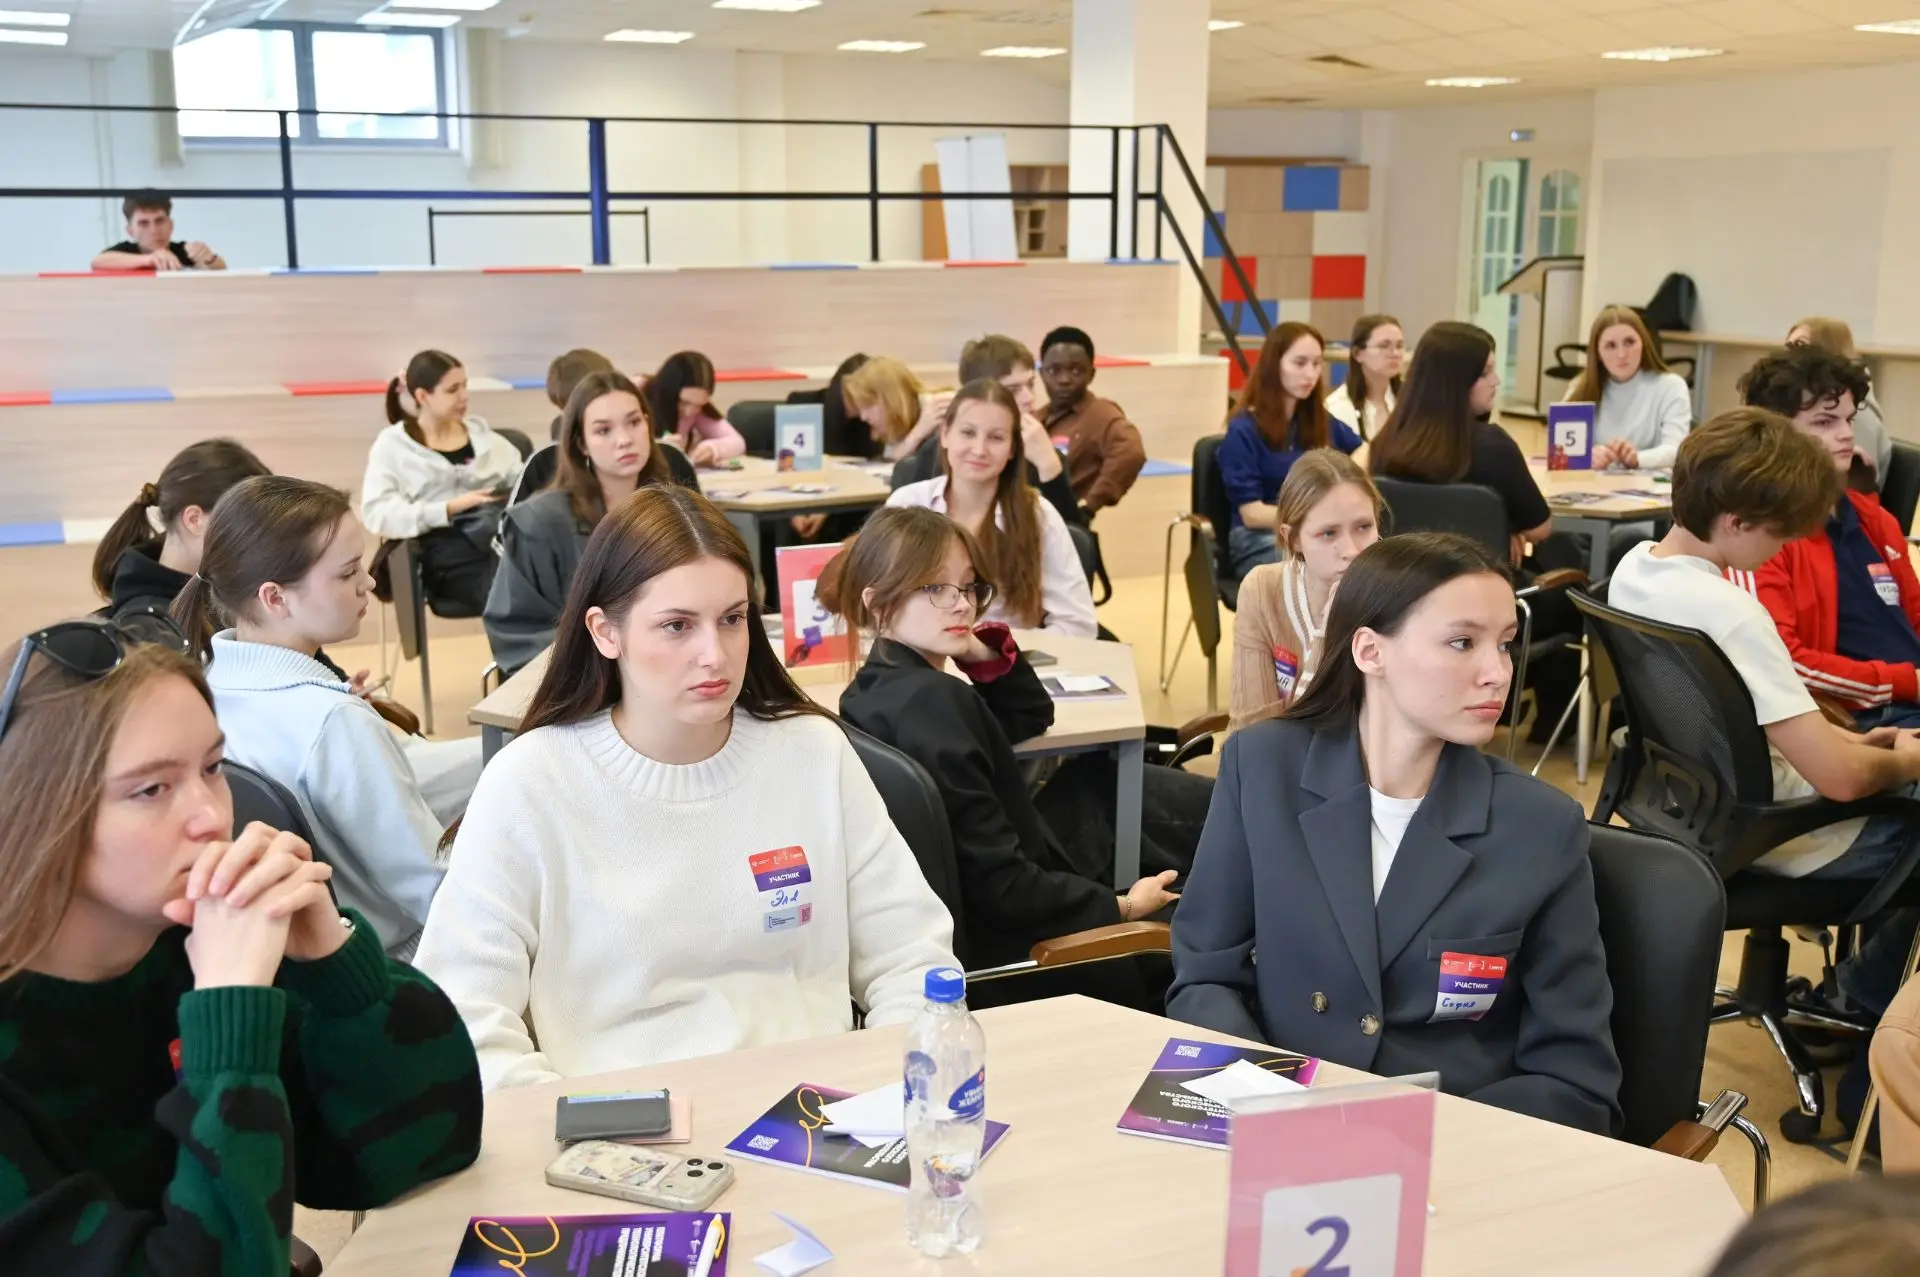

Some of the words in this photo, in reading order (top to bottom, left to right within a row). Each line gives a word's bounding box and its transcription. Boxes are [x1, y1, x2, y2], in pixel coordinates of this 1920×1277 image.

[793, 432, 806, 447] 4
[1564, 430, 1577, 447] 5
[768, 871, 801, 883] УЧАСТНИК
[1454, 981, 1489, 989] УЧАСТНИК
[1441, 998, 1476, 1011] София
[1304, 1215, 1351, 1277] 2
